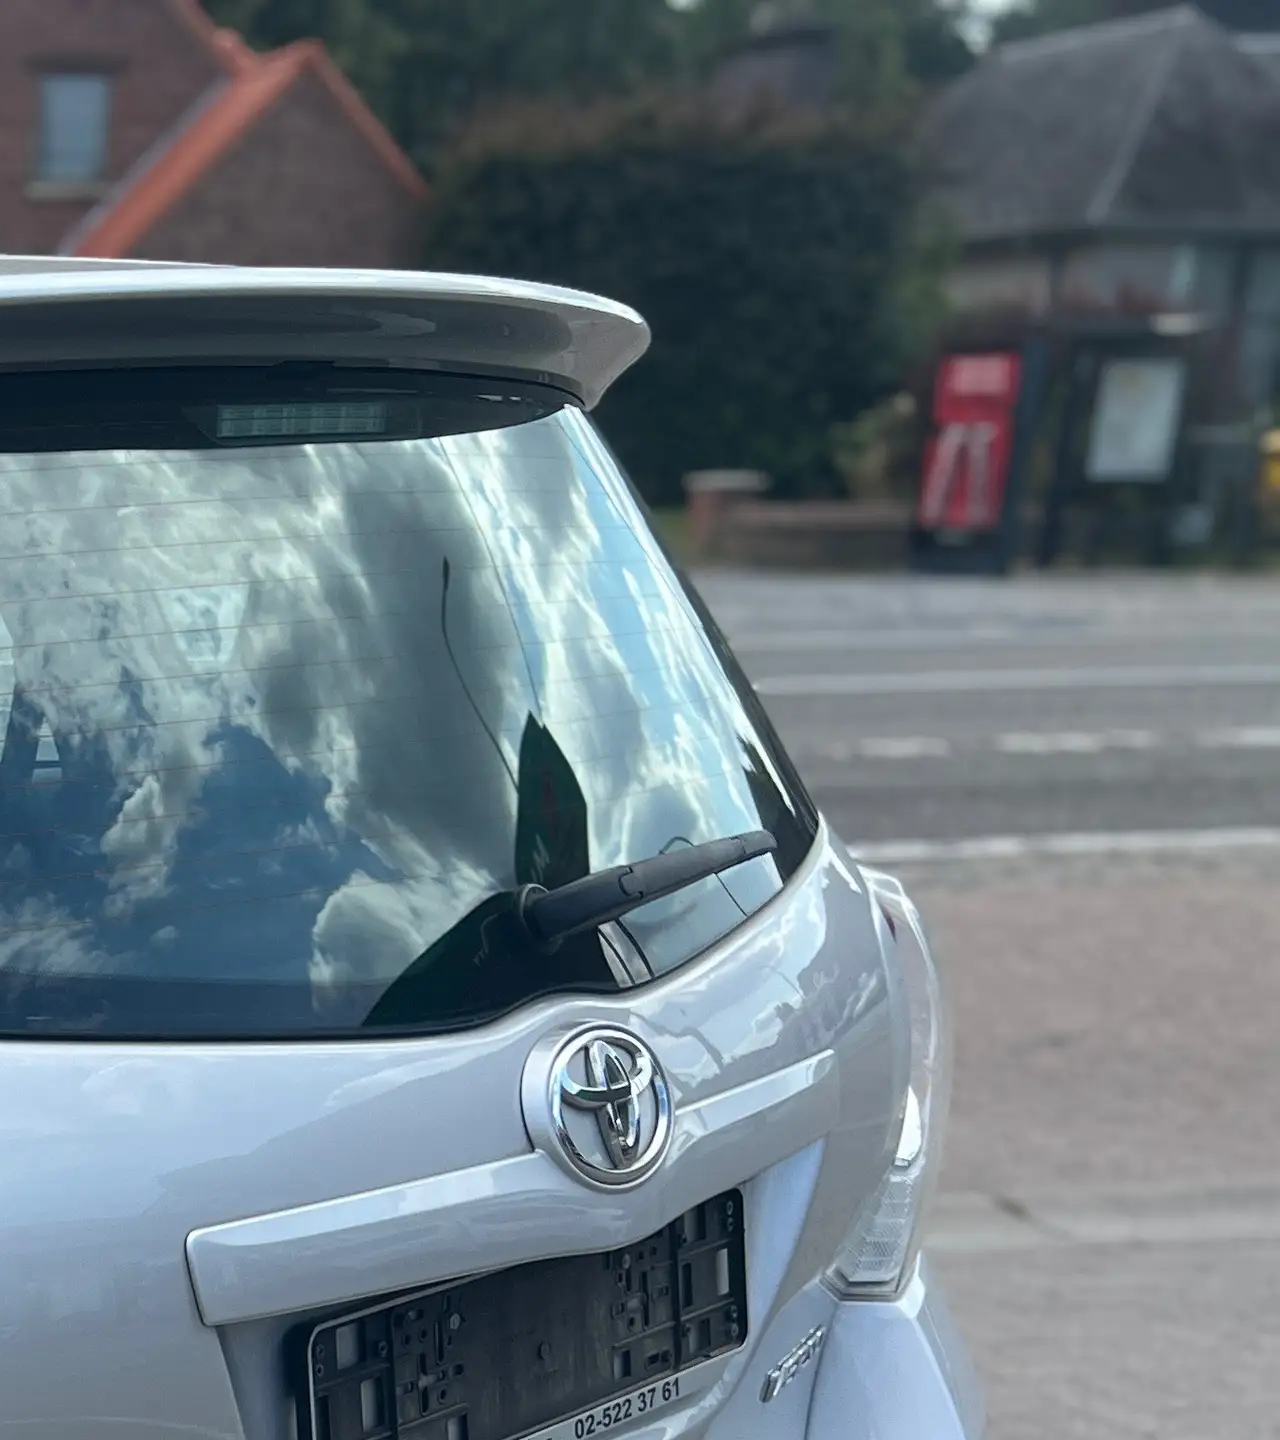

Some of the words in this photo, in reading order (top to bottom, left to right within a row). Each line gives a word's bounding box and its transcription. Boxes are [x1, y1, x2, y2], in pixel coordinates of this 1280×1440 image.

[574, 1398, 633, 1439] 02-522
[637, 1388, 656, 1412] 37
[662, 1377, 680, 1401] 61
